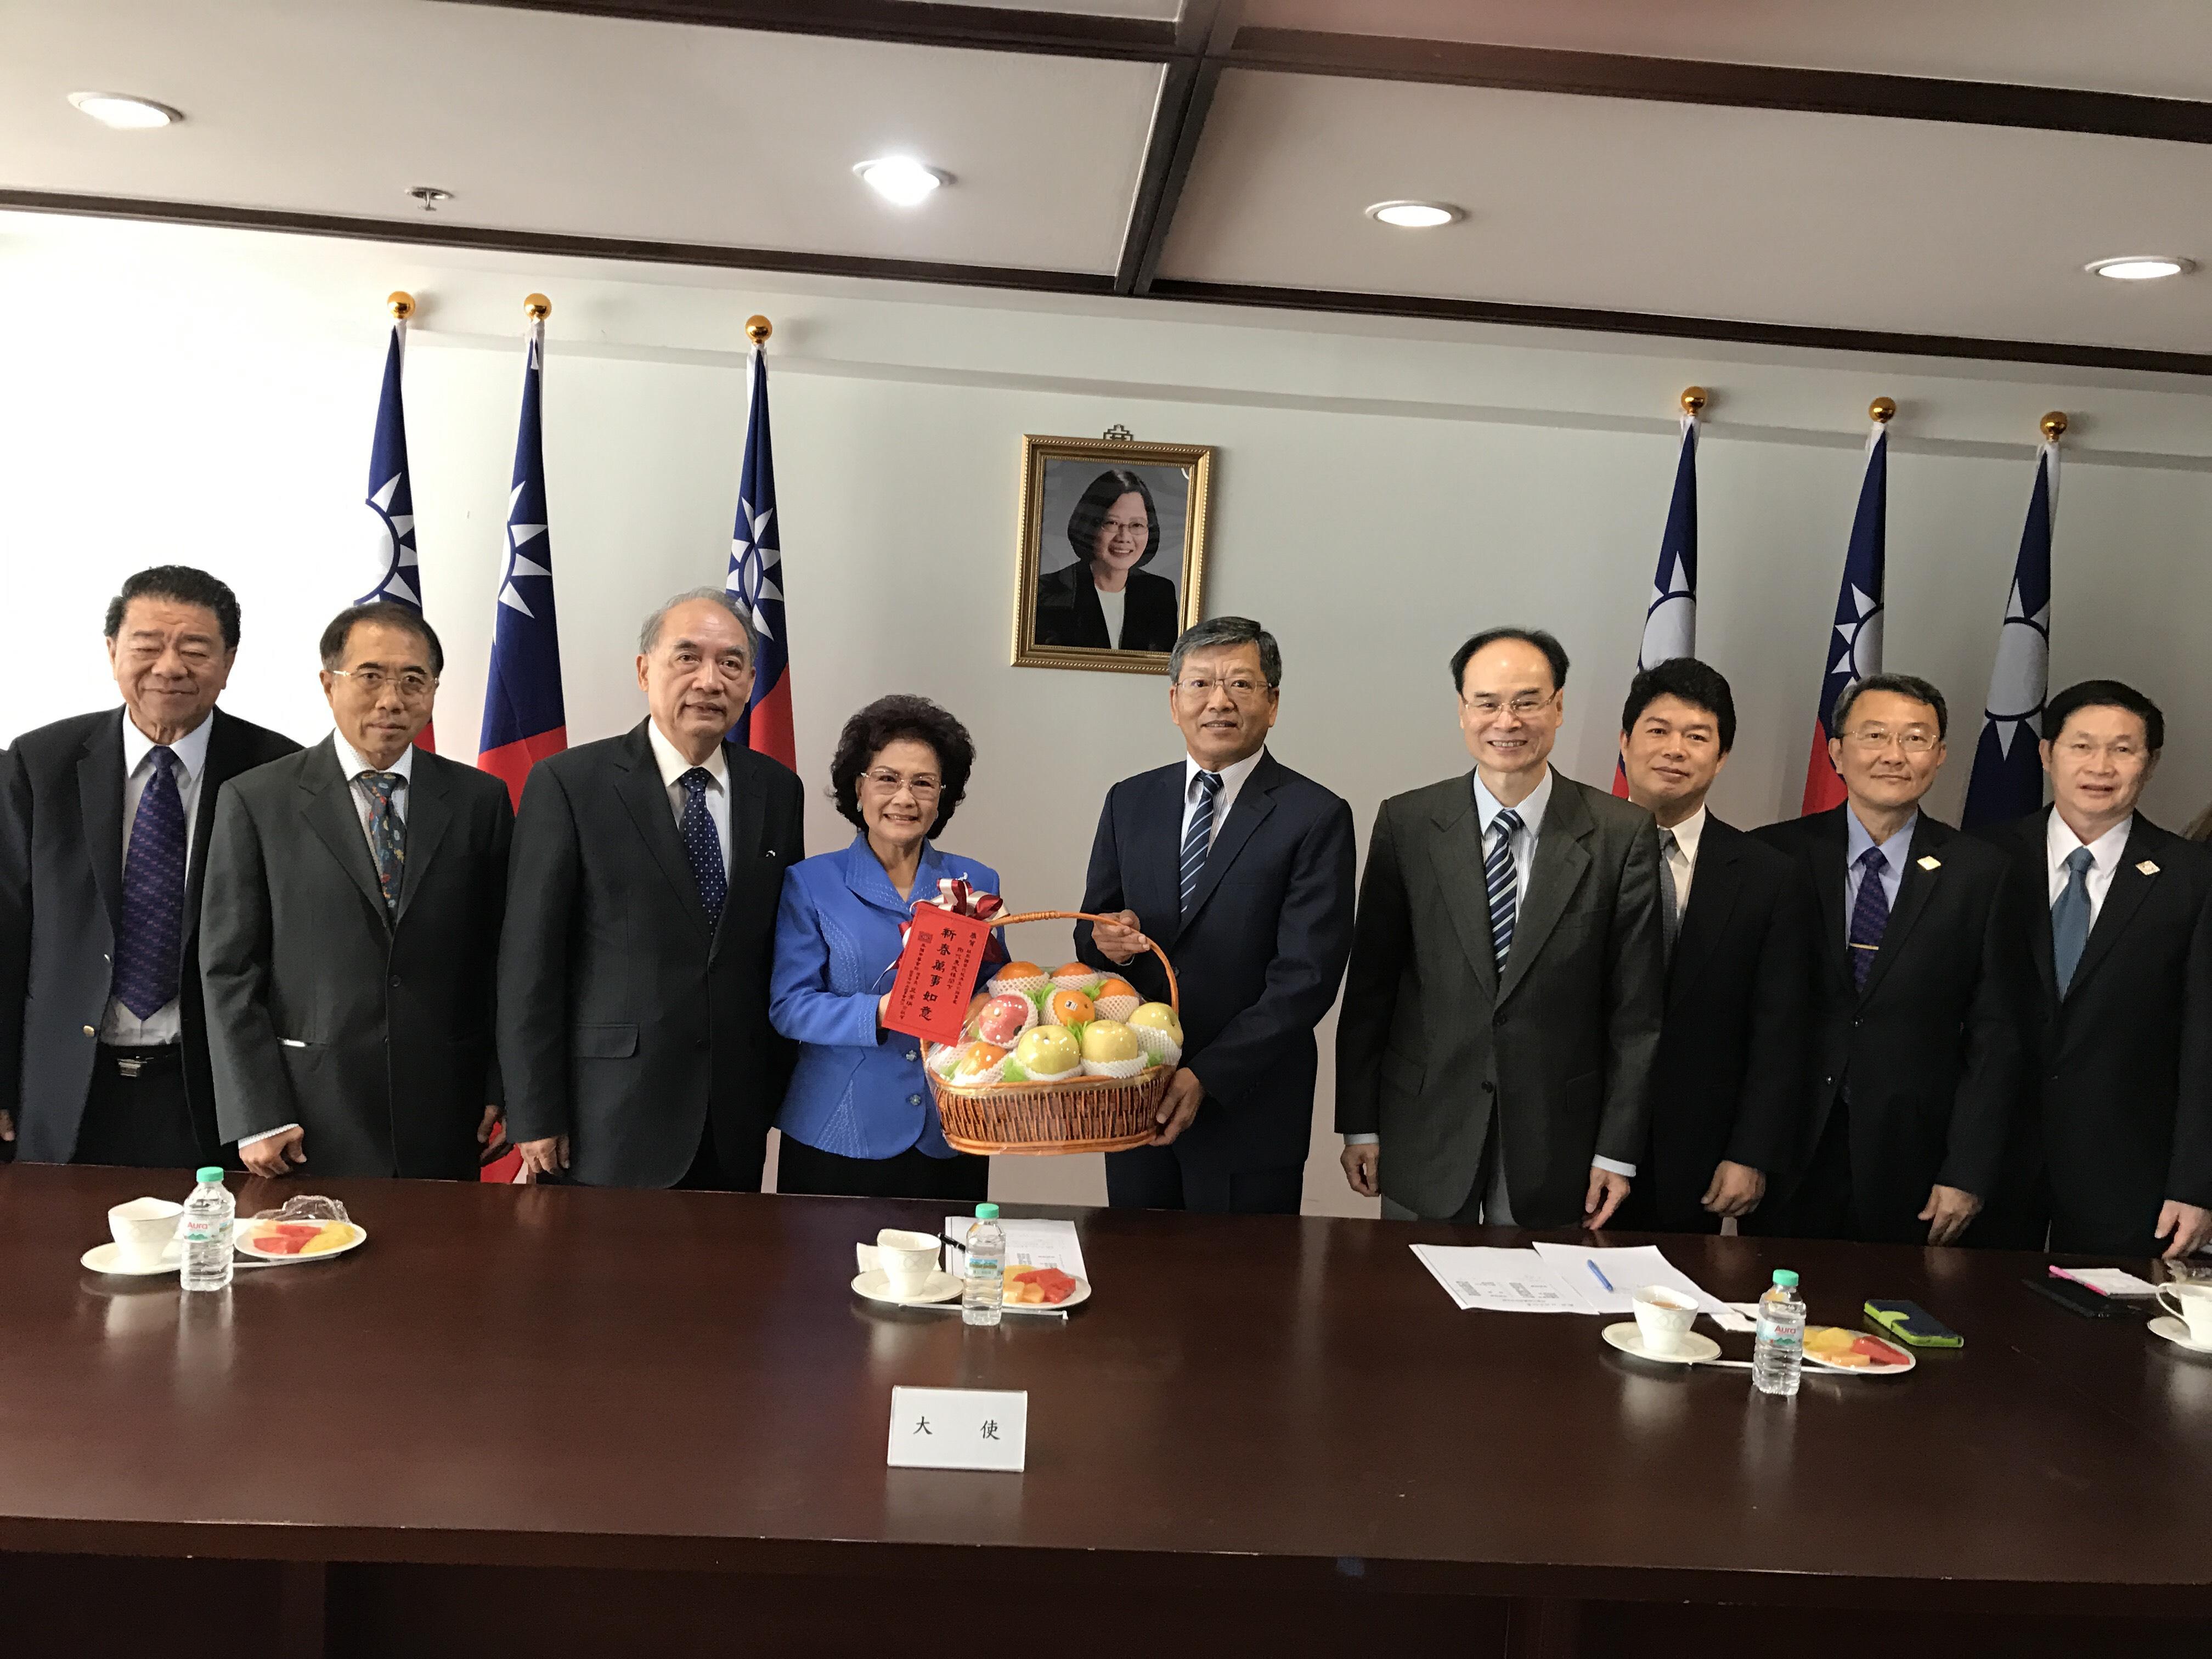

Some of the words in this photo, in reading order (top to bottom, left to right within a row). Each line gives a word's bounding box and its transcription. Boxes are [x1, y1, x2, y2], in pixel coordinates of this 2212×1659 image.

[918, 927, 957, 1022] 新春萬事如意
[1774, 1325, 1796, 1334] Aura
[913, 1416, 1000, 1440] 大使
